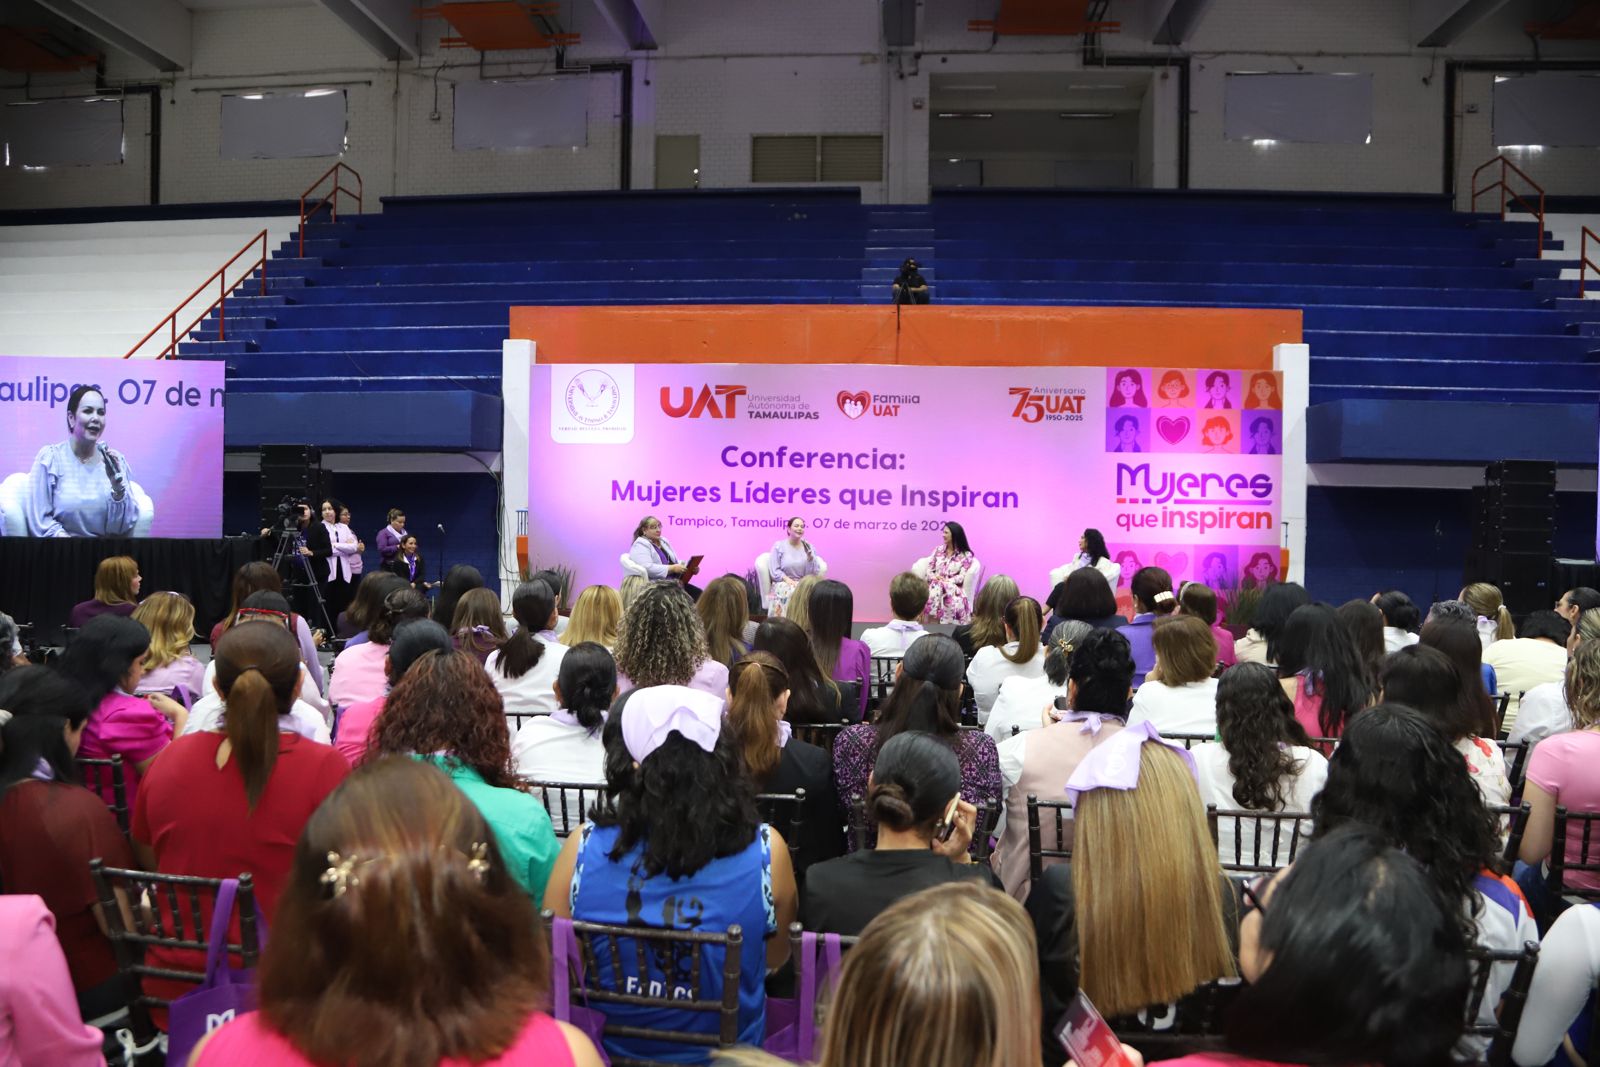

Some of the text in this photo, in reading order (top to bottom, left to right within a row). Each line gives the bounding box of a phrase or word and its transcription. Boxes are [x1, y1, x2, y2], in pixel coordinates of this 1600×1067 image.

[165, 381, 201, 407] de
[747, 394, 801, 402] Universidad
[873, 394, 920, 404] Familia
[1033, 386, 1086, 395] Aniversario
[660, 383, 747, 418] UAT
[747, 402, 810, 410] Autónoma de
[1009, 387, 1045, 423] 75
[1045, 395, 1086, 414] UAT
[748, 410, 820, 420] TAMAULIPAS
[873, 405, 900, 417] UAT
[721, 445, 905, 470] Conferencia:
[1116, 462, 1273, 504] Mujeres
[611, 479, 1019, 512] Mujeres Líderes que Inspiran
[668, 515, 727, 529] Tampico,
[833, 518, 850, 529] de
[854, 521, 897, 531] marzo
[901, 519, 917, 531] de
[921, 520, 947, 531] 202
[1116, 506, 1273, 534] que inspiran
